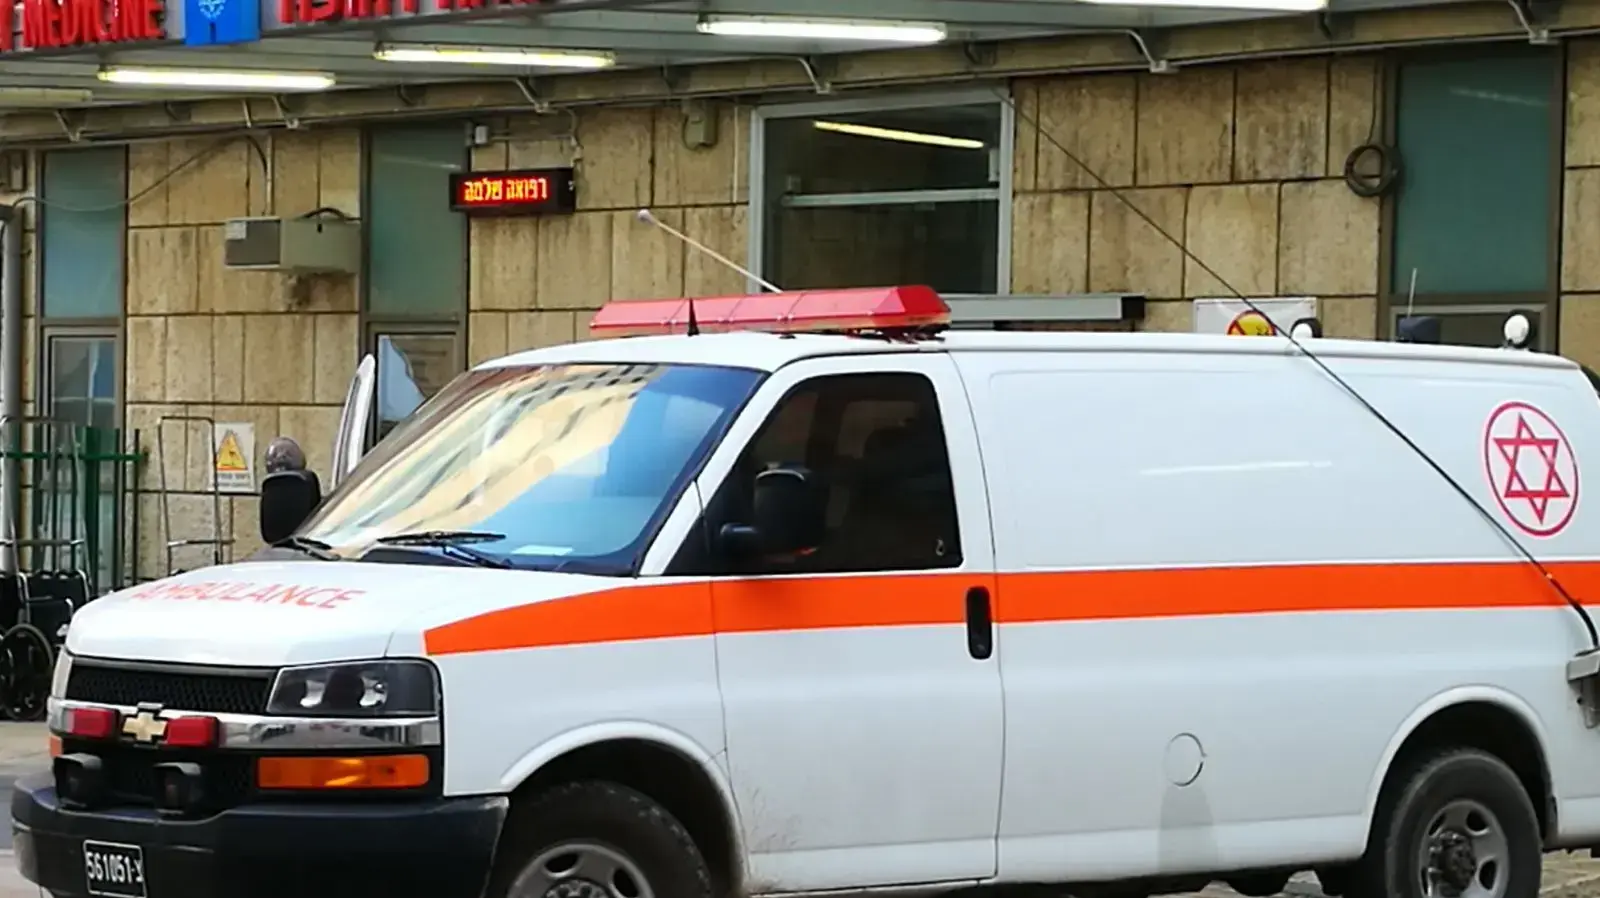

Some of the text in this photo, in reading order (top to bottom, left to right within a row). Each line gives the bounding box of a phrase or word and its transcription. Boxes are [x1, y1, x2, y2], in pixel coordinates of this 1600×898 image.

[23, 0, 166, 48] MEDICINE
[464, 177, 548, 201] רפואה שלמה
[130, 582, 367, 609] AMBULANCE
